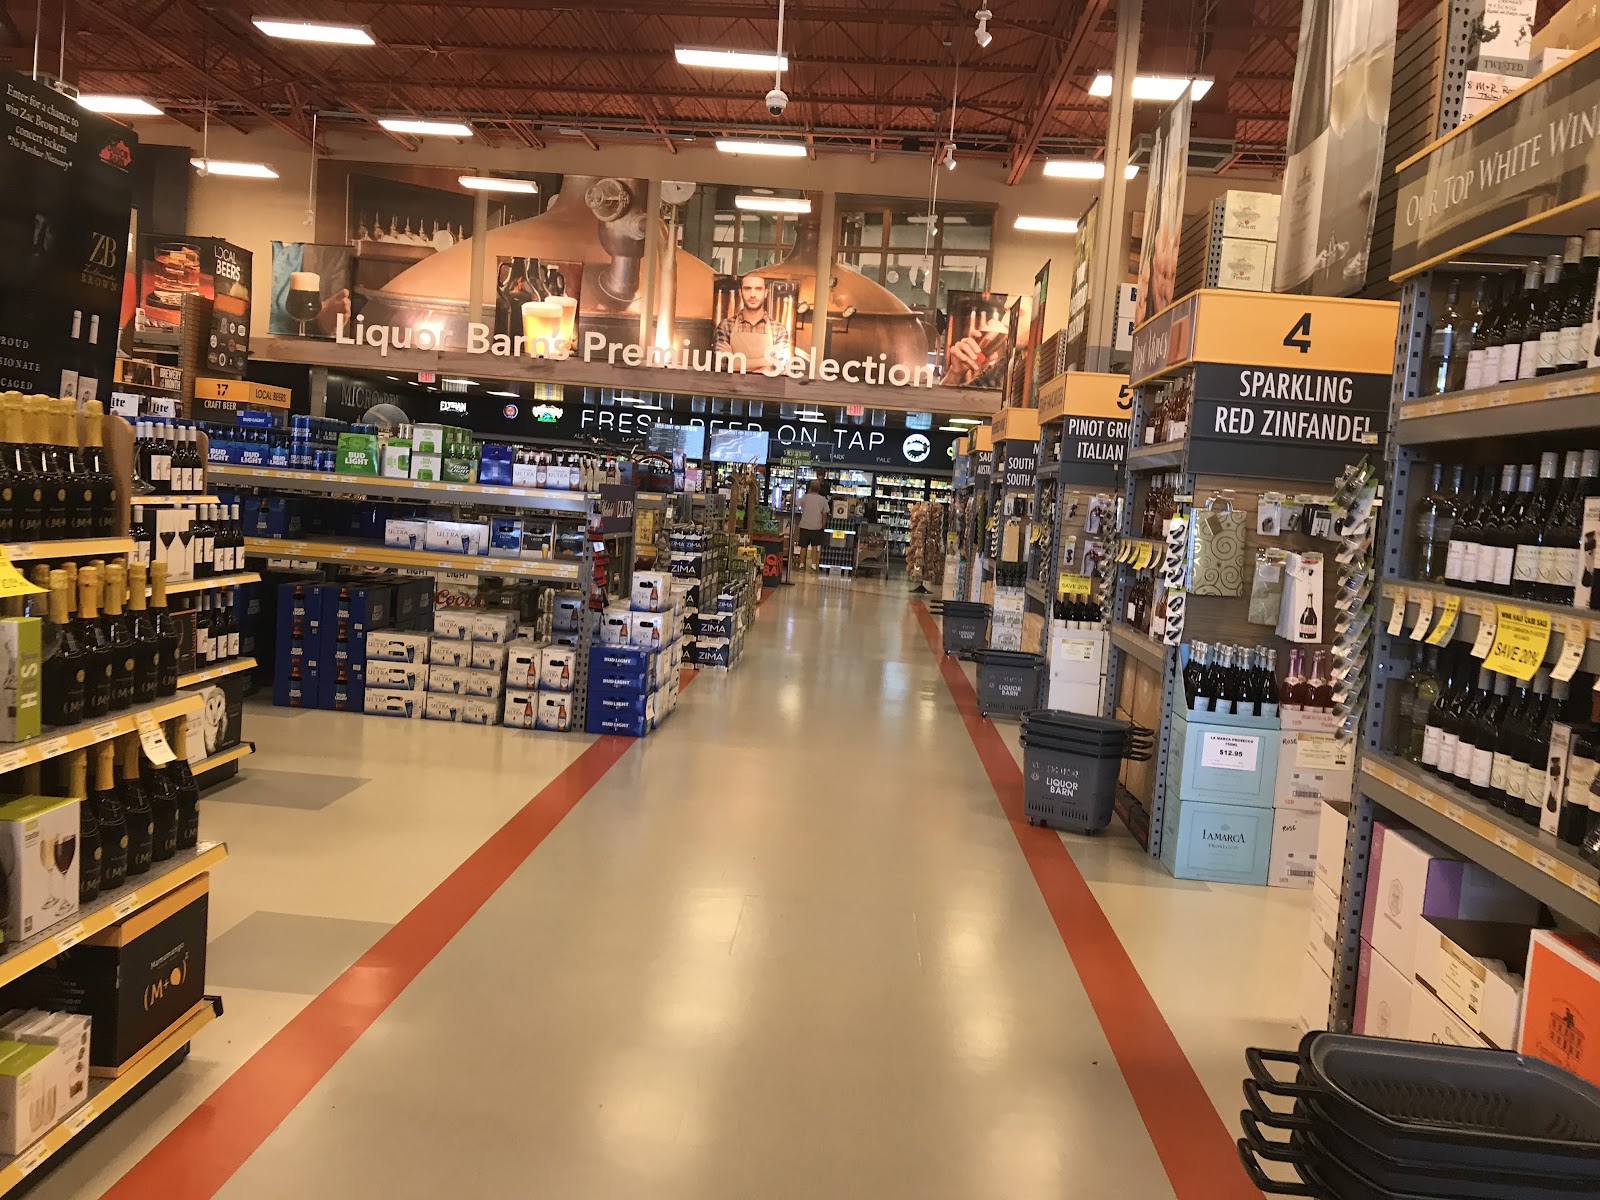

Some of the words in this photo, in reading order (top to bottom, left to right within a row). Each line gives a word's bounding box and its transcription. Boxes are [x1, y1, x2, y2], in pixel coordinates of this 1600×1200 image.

[1484, 60, 1524, 72] TWISTED
[7, 83, 29, 103] Enter
[29, 94, 41, 109] for
[47, 103, 71, 123] chance
[71, 117, 79, 127] to
[5, 102, 19, 116] win
[20, 107, 34, 123] Zac
[35, 114, 58, 134] Brown
[60, 125, 78, 143] Band
[15, 125, 43, 144] concert
[44, 136, 67, 154] tickets
[1406, 188, 1438, 227] OUR
[1444, 169, 1475, 209] TOP
[1479, 133, 1543, 192] WHITE
[89, 231, 117, 268] ZB
[214, 245, 236, 264] LOCAL
[216, 259, 240, 282] BEERS
[81, 272, 119, 291] BROWN
[1283, 312, 1313, 354] 4
[0, 336, 29, 349] ROUD
[336, 312, 453, 357] Liquor
[466, 322, 570, 361] Barn's
[583, 331, 747, 375] Premium
[762, 344, 934, 389] Selection
[159, 367, 182, 381] BREWERY
[420, 372, 433, 383] EXIT
[164, 379, 181, 390] MONTH
[216, 383, 229, 396] 17
[1239, 370, 1353, 405] SPARKLING
[255, 388, 272, 400] LOCAL
[273, 390, 287, 403] BEERS
[1117, 384, 1133, 410] 5
[152, 403, 169, 414] Lite
[203, 400, 221, 410] CRAFT
[222, 401, 237, 411] BEER
[849, 405, 863, 415] EXIT
[1068, 418, 1104, 436] PINOT
[1215, 406, 1254, 434] RED
[1260, 409, 1372, 443] ZINFANDEL
[777, 424, 818, 447] ON
[833, 429, 885, 451] TAP
[207, 453, 230, 462] LIGHT
[210, 448, 226, 456] BUD
[347, 451, 366, 460] BUD
[1077, 442, 1124, 461] ITALIAN
[344, 457, 369, 466] LIGHT
[1008, 457, 1035, 471] SOUTH
[1006, 473, 1032, 486] SOUTH
[671, 565, 696, 574] ZIMA
[433, 589, 478, 606] Coors
[701, 624, 726, 633] ZIMA
[699, 651, 723, 661] ZIMA
[1494, 642, 1520, 661] SAVE
[20, 652, 38, 710] HOST
[999, 684, 1022, 693] LIQUOR
[1001, 689, 1019, 697] BARN
[1219, 749, 1243, 757] $12.95
[1046, 777, 1079, 790] LIQUOR
[1050, 786, 1074, 797] BARN
